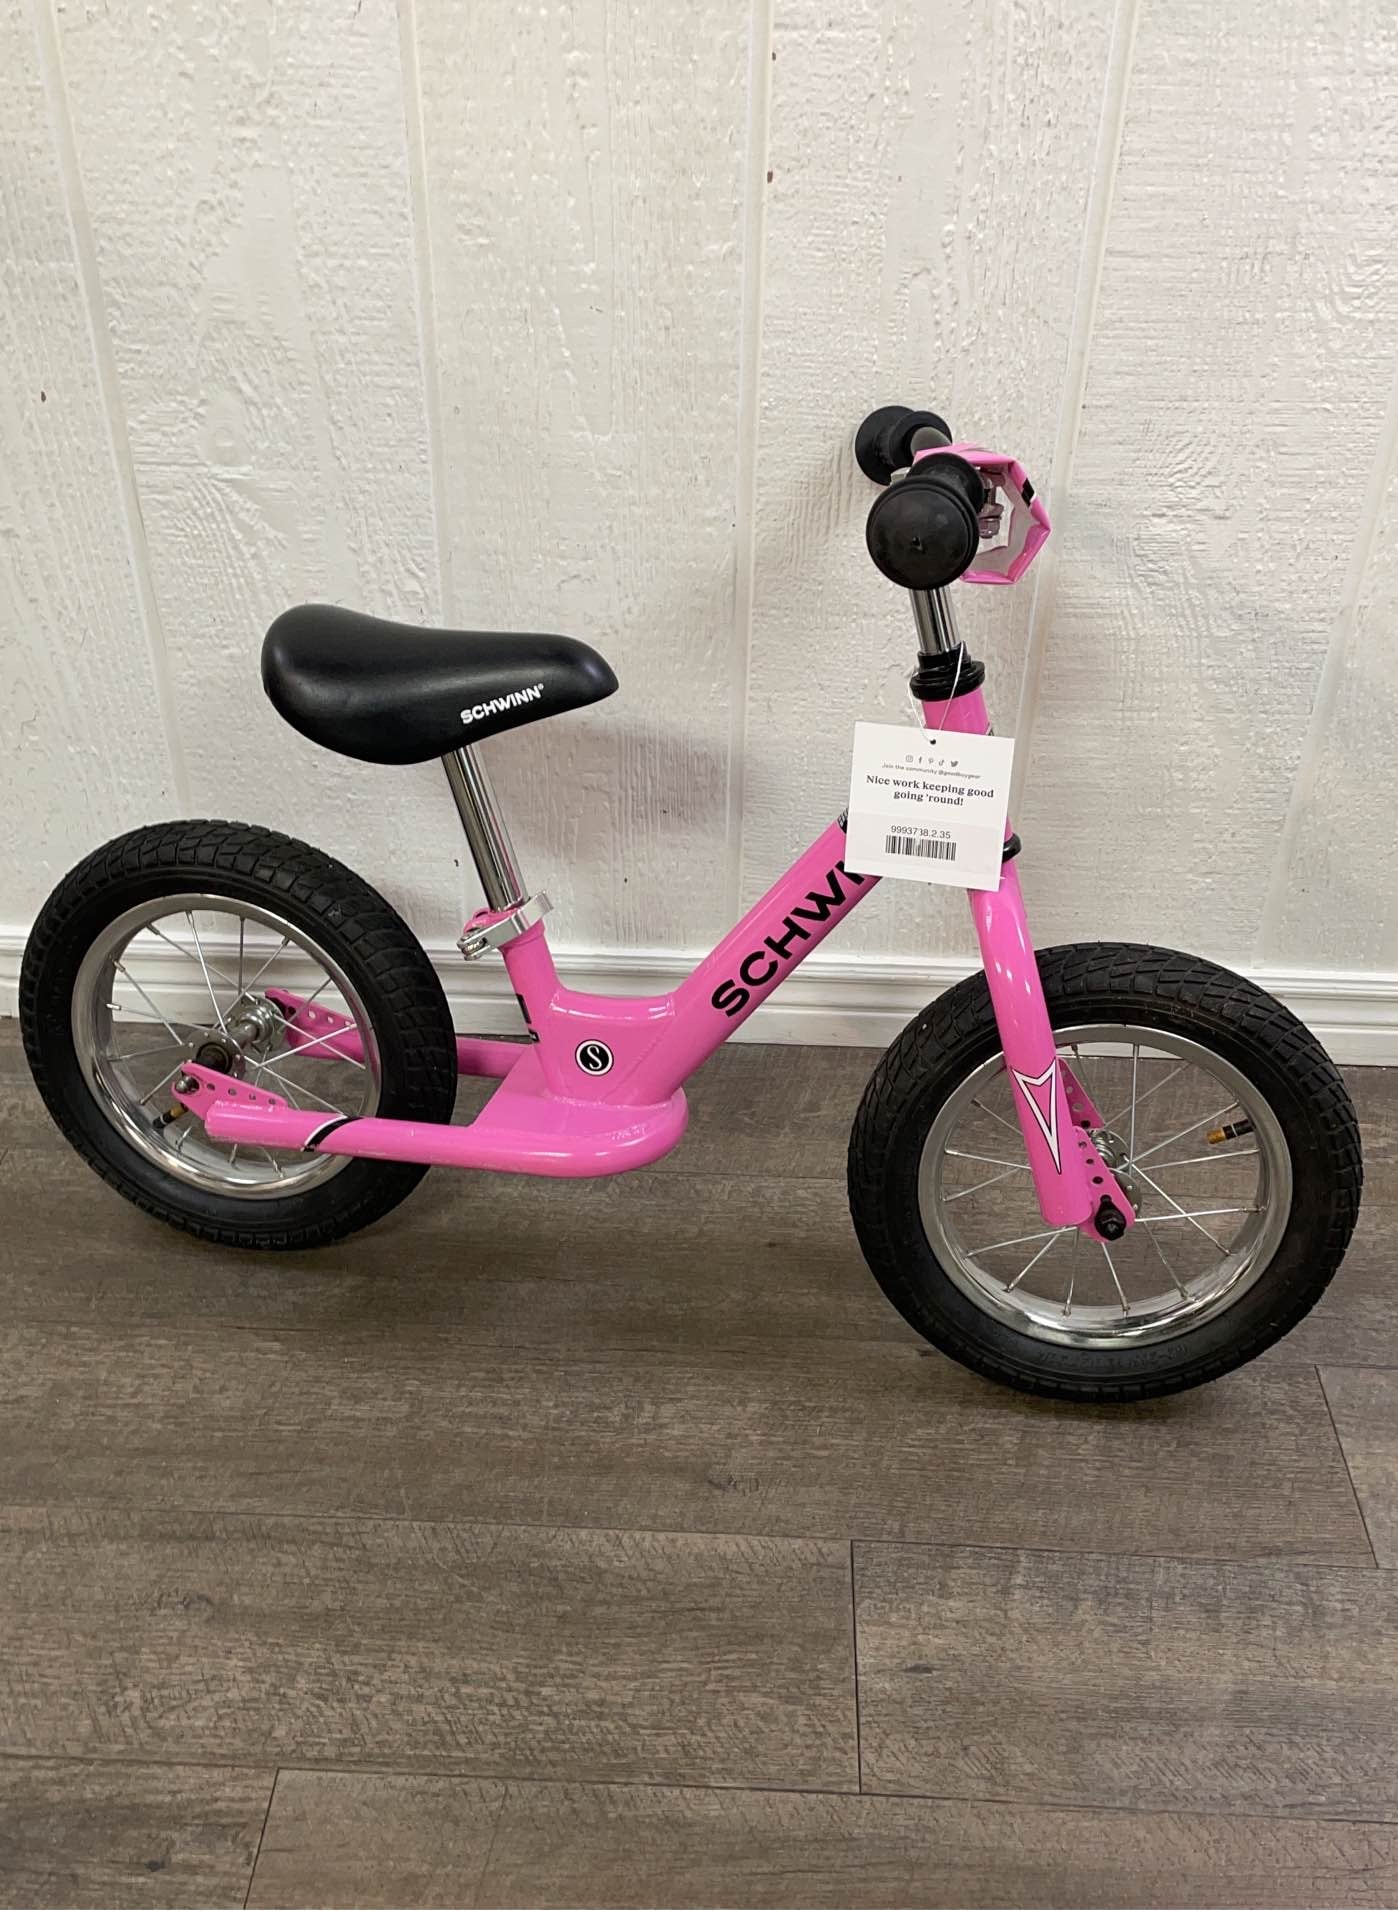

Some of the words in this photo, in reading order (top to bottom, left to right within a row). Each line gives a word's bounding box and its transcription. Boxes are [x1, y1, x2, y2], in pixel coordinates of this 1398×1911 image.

[906, 766, 938, 775] community
[866, 775, 890, 786] Nice
[892, 778, 920, 789] work
[922, 781, 965, 796] keeping
[967, 788, 995, 798] good
[893, 790, 924, 802] going
[926, 793, 964, 806] 'round!
[711, 860, 866, 1018] SCHWI
